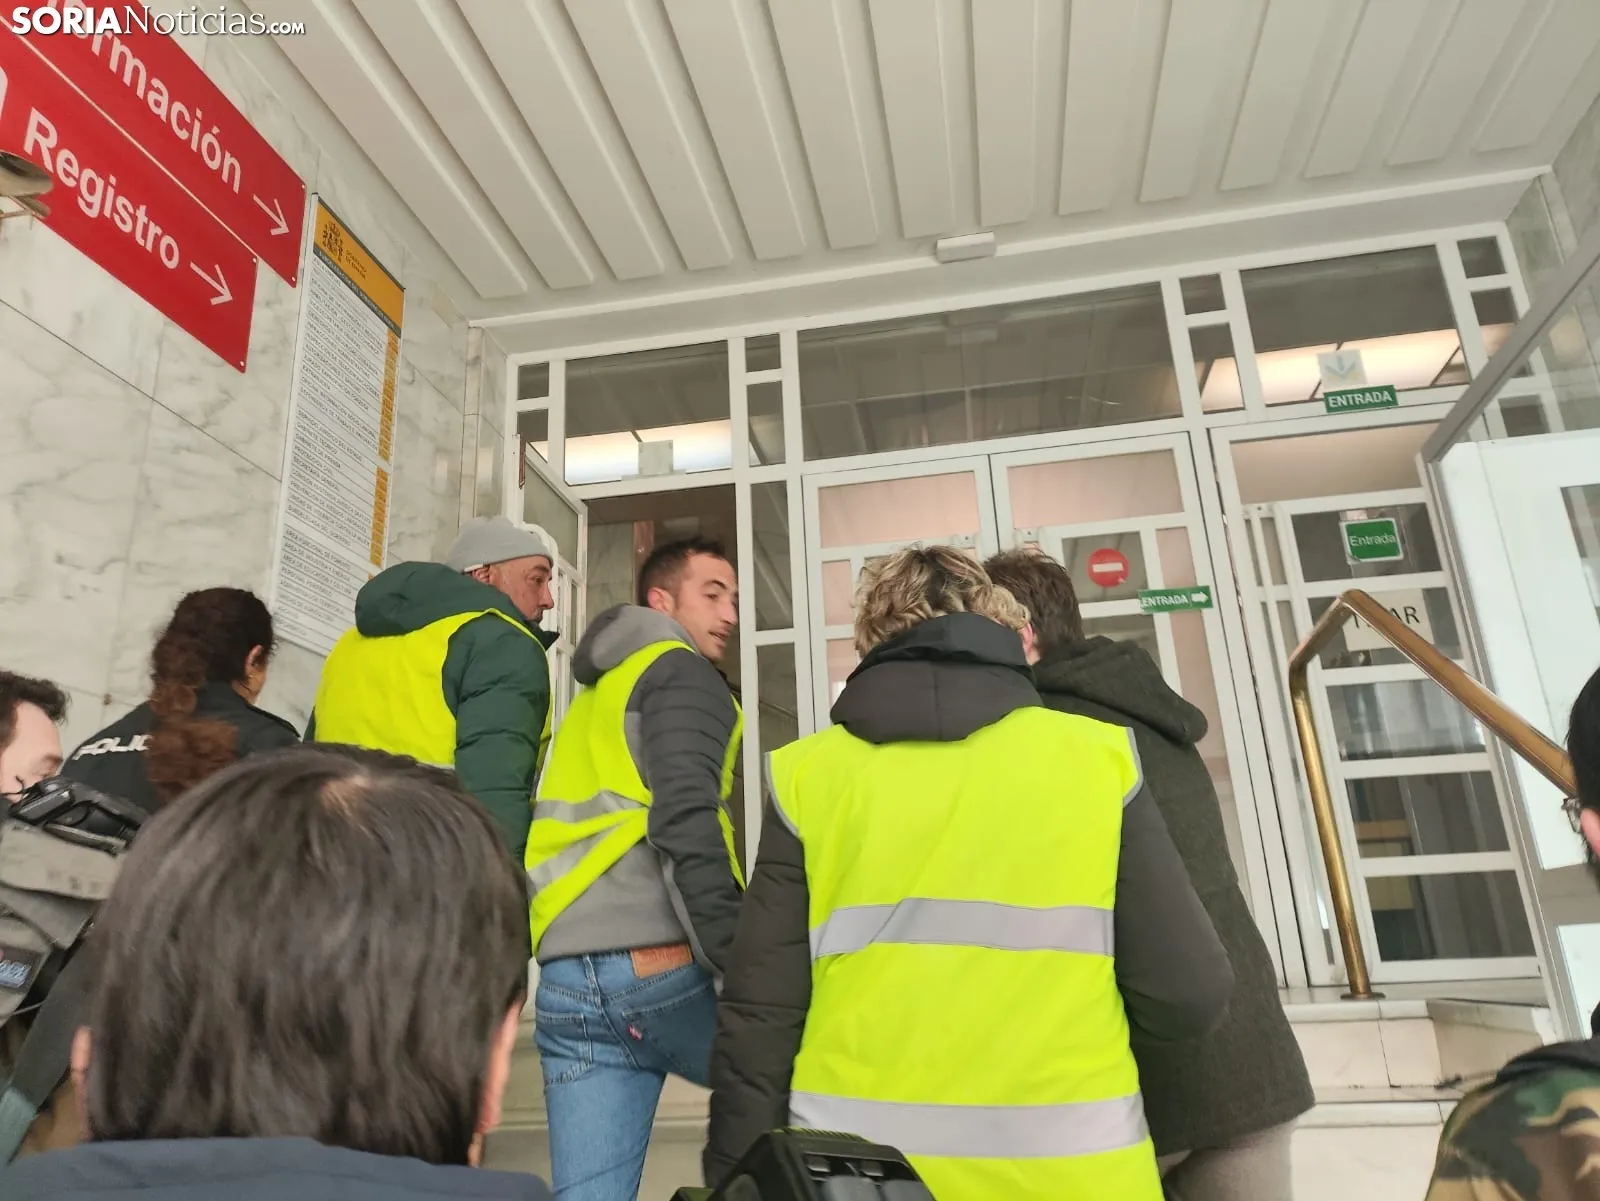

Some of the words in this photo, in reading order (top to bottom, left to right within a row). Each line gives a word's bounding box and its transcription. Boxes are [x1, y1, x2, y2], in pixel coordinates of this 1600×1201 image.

[23, 106, 180, 270] Registro
[1327, 390, 1393, 408] ENTRADA
[1349, 533, 1398, 547] Entrada
[1141, 594, 1189, 608] ENTRADA
